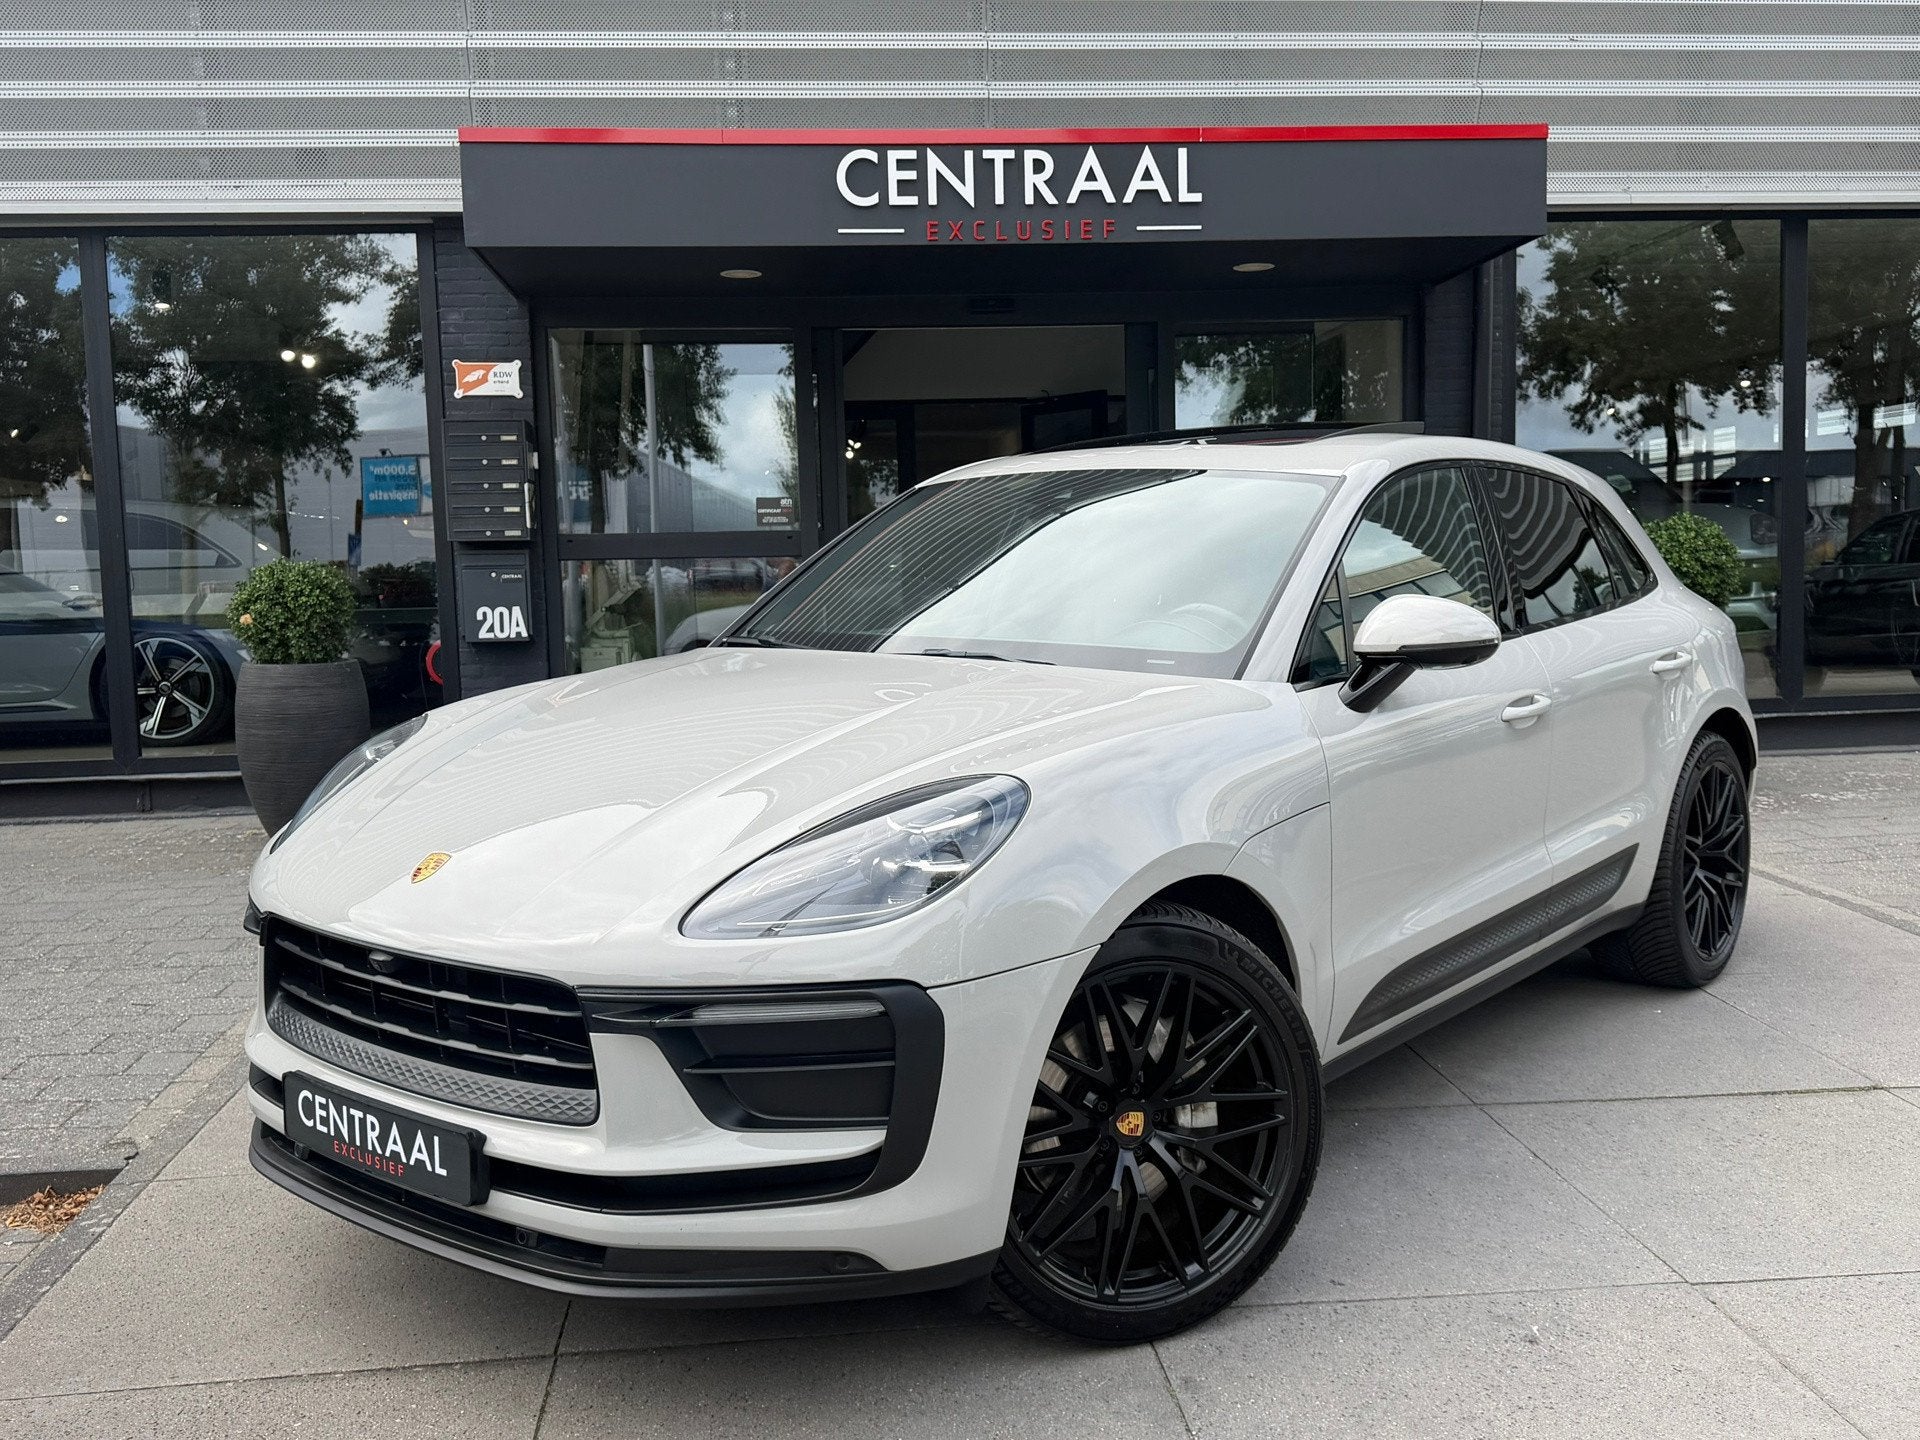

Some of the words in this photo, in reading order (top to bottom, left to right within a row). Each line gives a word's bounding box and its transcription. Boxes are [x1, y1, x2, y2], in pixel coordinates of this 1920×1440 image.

[836, 144, 1203, 208] CENTRAAL
[926, 219, 1116, 242] EXCLUSIEF
[476, 605, 529, 639] 20A
[297, 1089, 448, 1177] CENTRAAL
[333, 1140, 405, 1178] EXCLUSIEF
